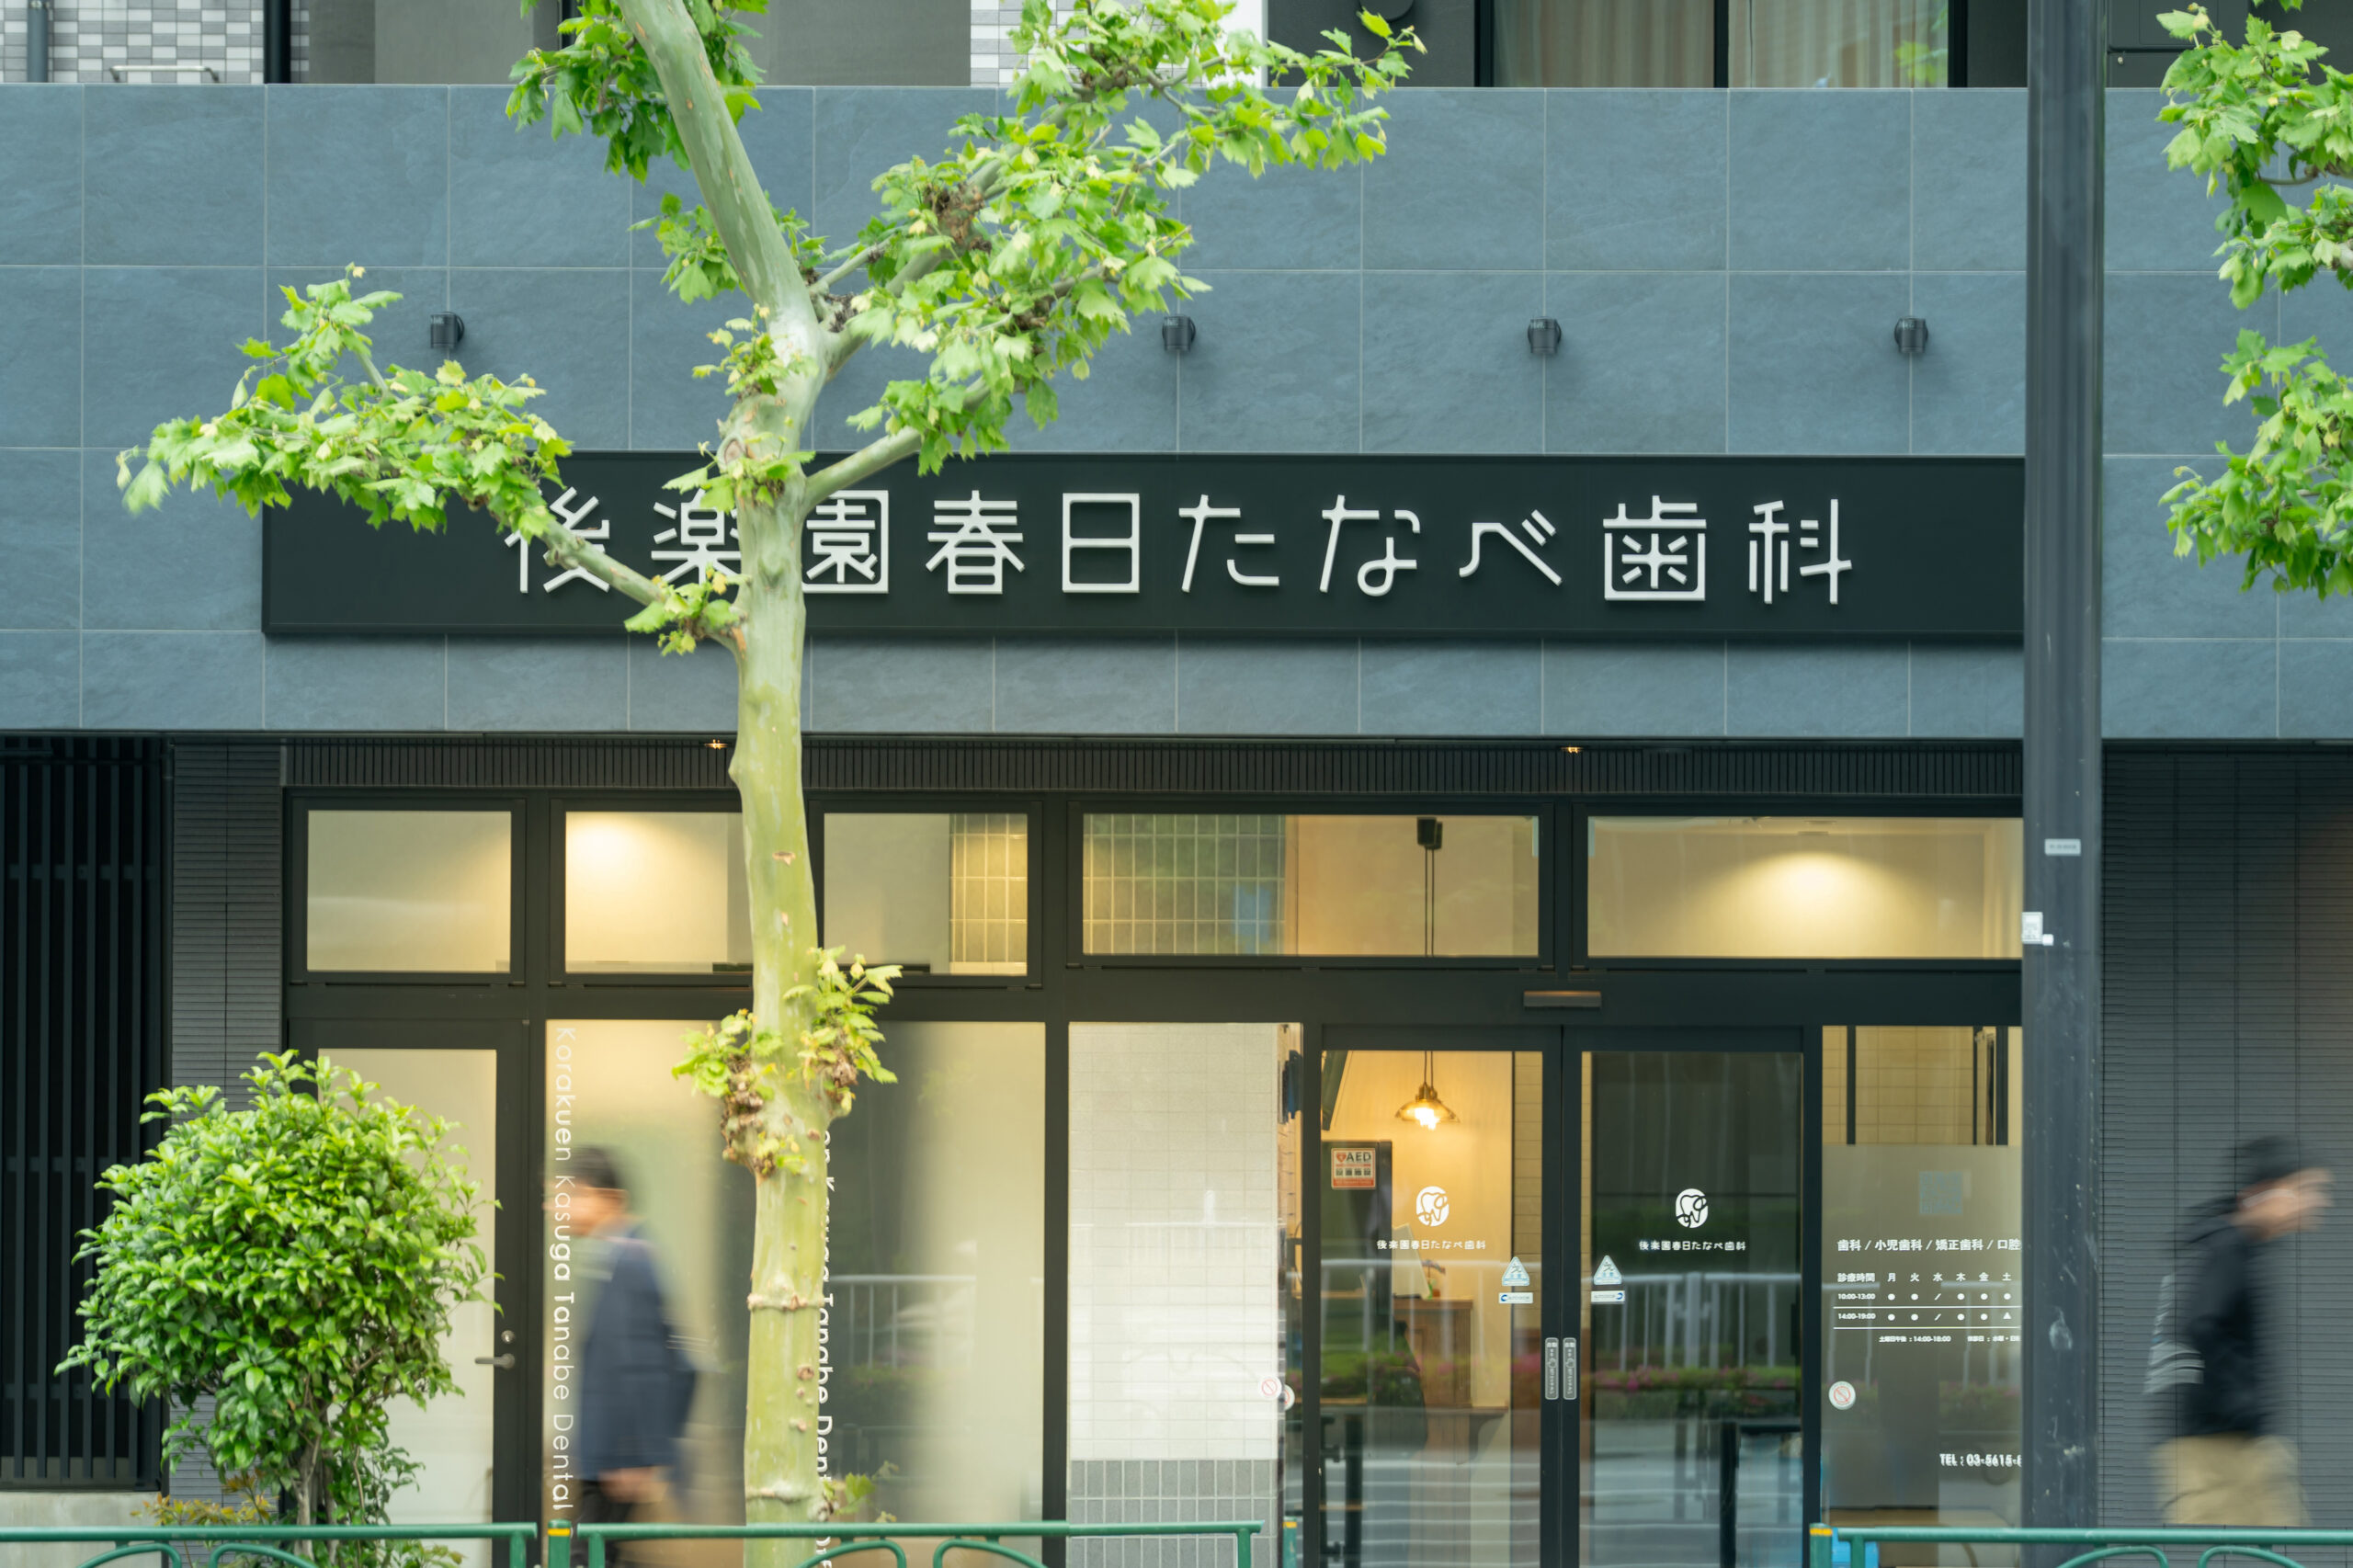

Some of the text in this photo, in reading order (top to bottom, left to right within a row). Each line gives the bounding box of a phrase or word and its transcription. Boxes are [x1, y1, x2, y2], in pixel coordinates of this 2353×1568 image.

[1346, 1152, 1371, 1163] AED
[1836, 1238, 1862, 1252] 歯科
[1875, 1238, 1923, 1252] 小児歯科
[1936, 1238, 1984, 1252] 矯正歯科
[550, 1027, 576, 1510] Korakuen Kasuga Tanabe Dental
[1836, 1272, 2012, 1283] 診療時間 月 火 水 木 金 土
[1837, 1292, 1876, 1301] 10:00-13:00
[1939, 1454, 1958, 1468] TEL
